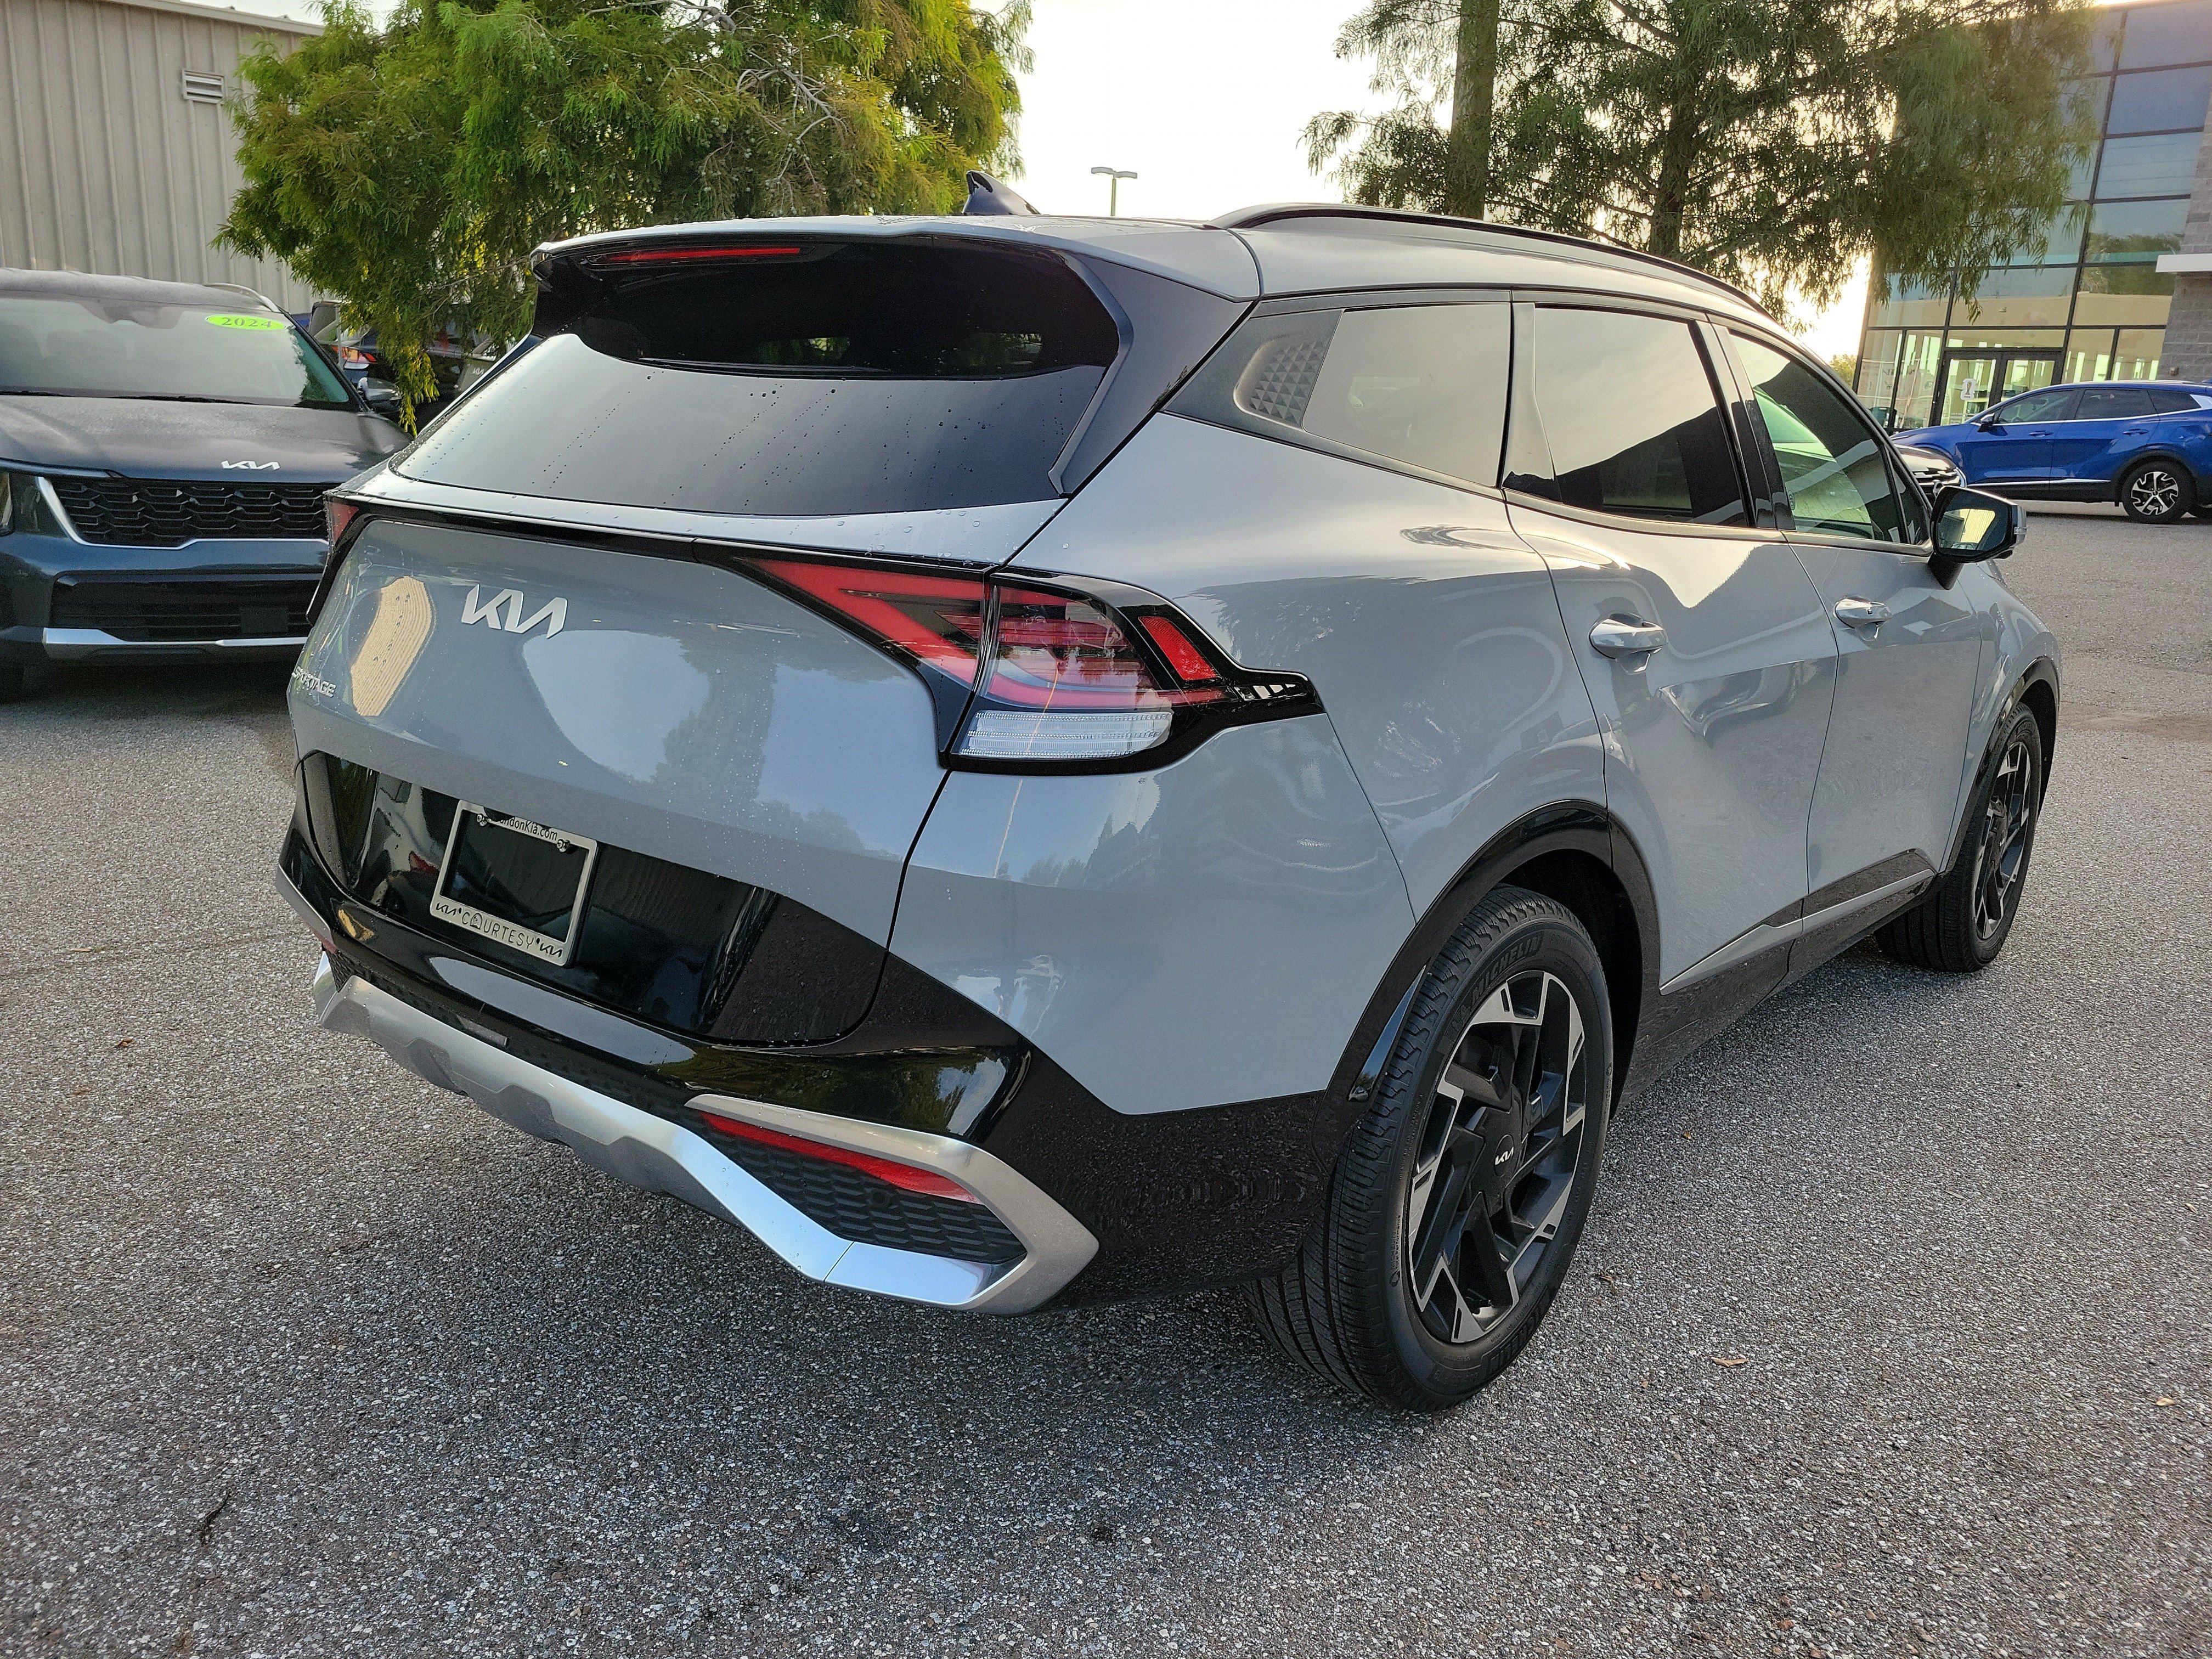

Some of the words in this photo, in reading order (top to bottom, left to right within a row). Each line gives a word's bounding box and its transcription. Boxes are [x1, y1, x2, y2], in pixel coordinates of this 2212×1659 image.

[222, 317, 273, 328] 2024
[221, 460, 281, 471] KIA
[461, 583, 568, 639] KIA
[436, 902, 456, 916] KIA
[461, 911, 534, 950] COURTESY
[539, 942, 563, 958] KIA
[1471, 934, 1542, 1004] MICHELIN
[1494, 1146, 1514, 1165] KIA
